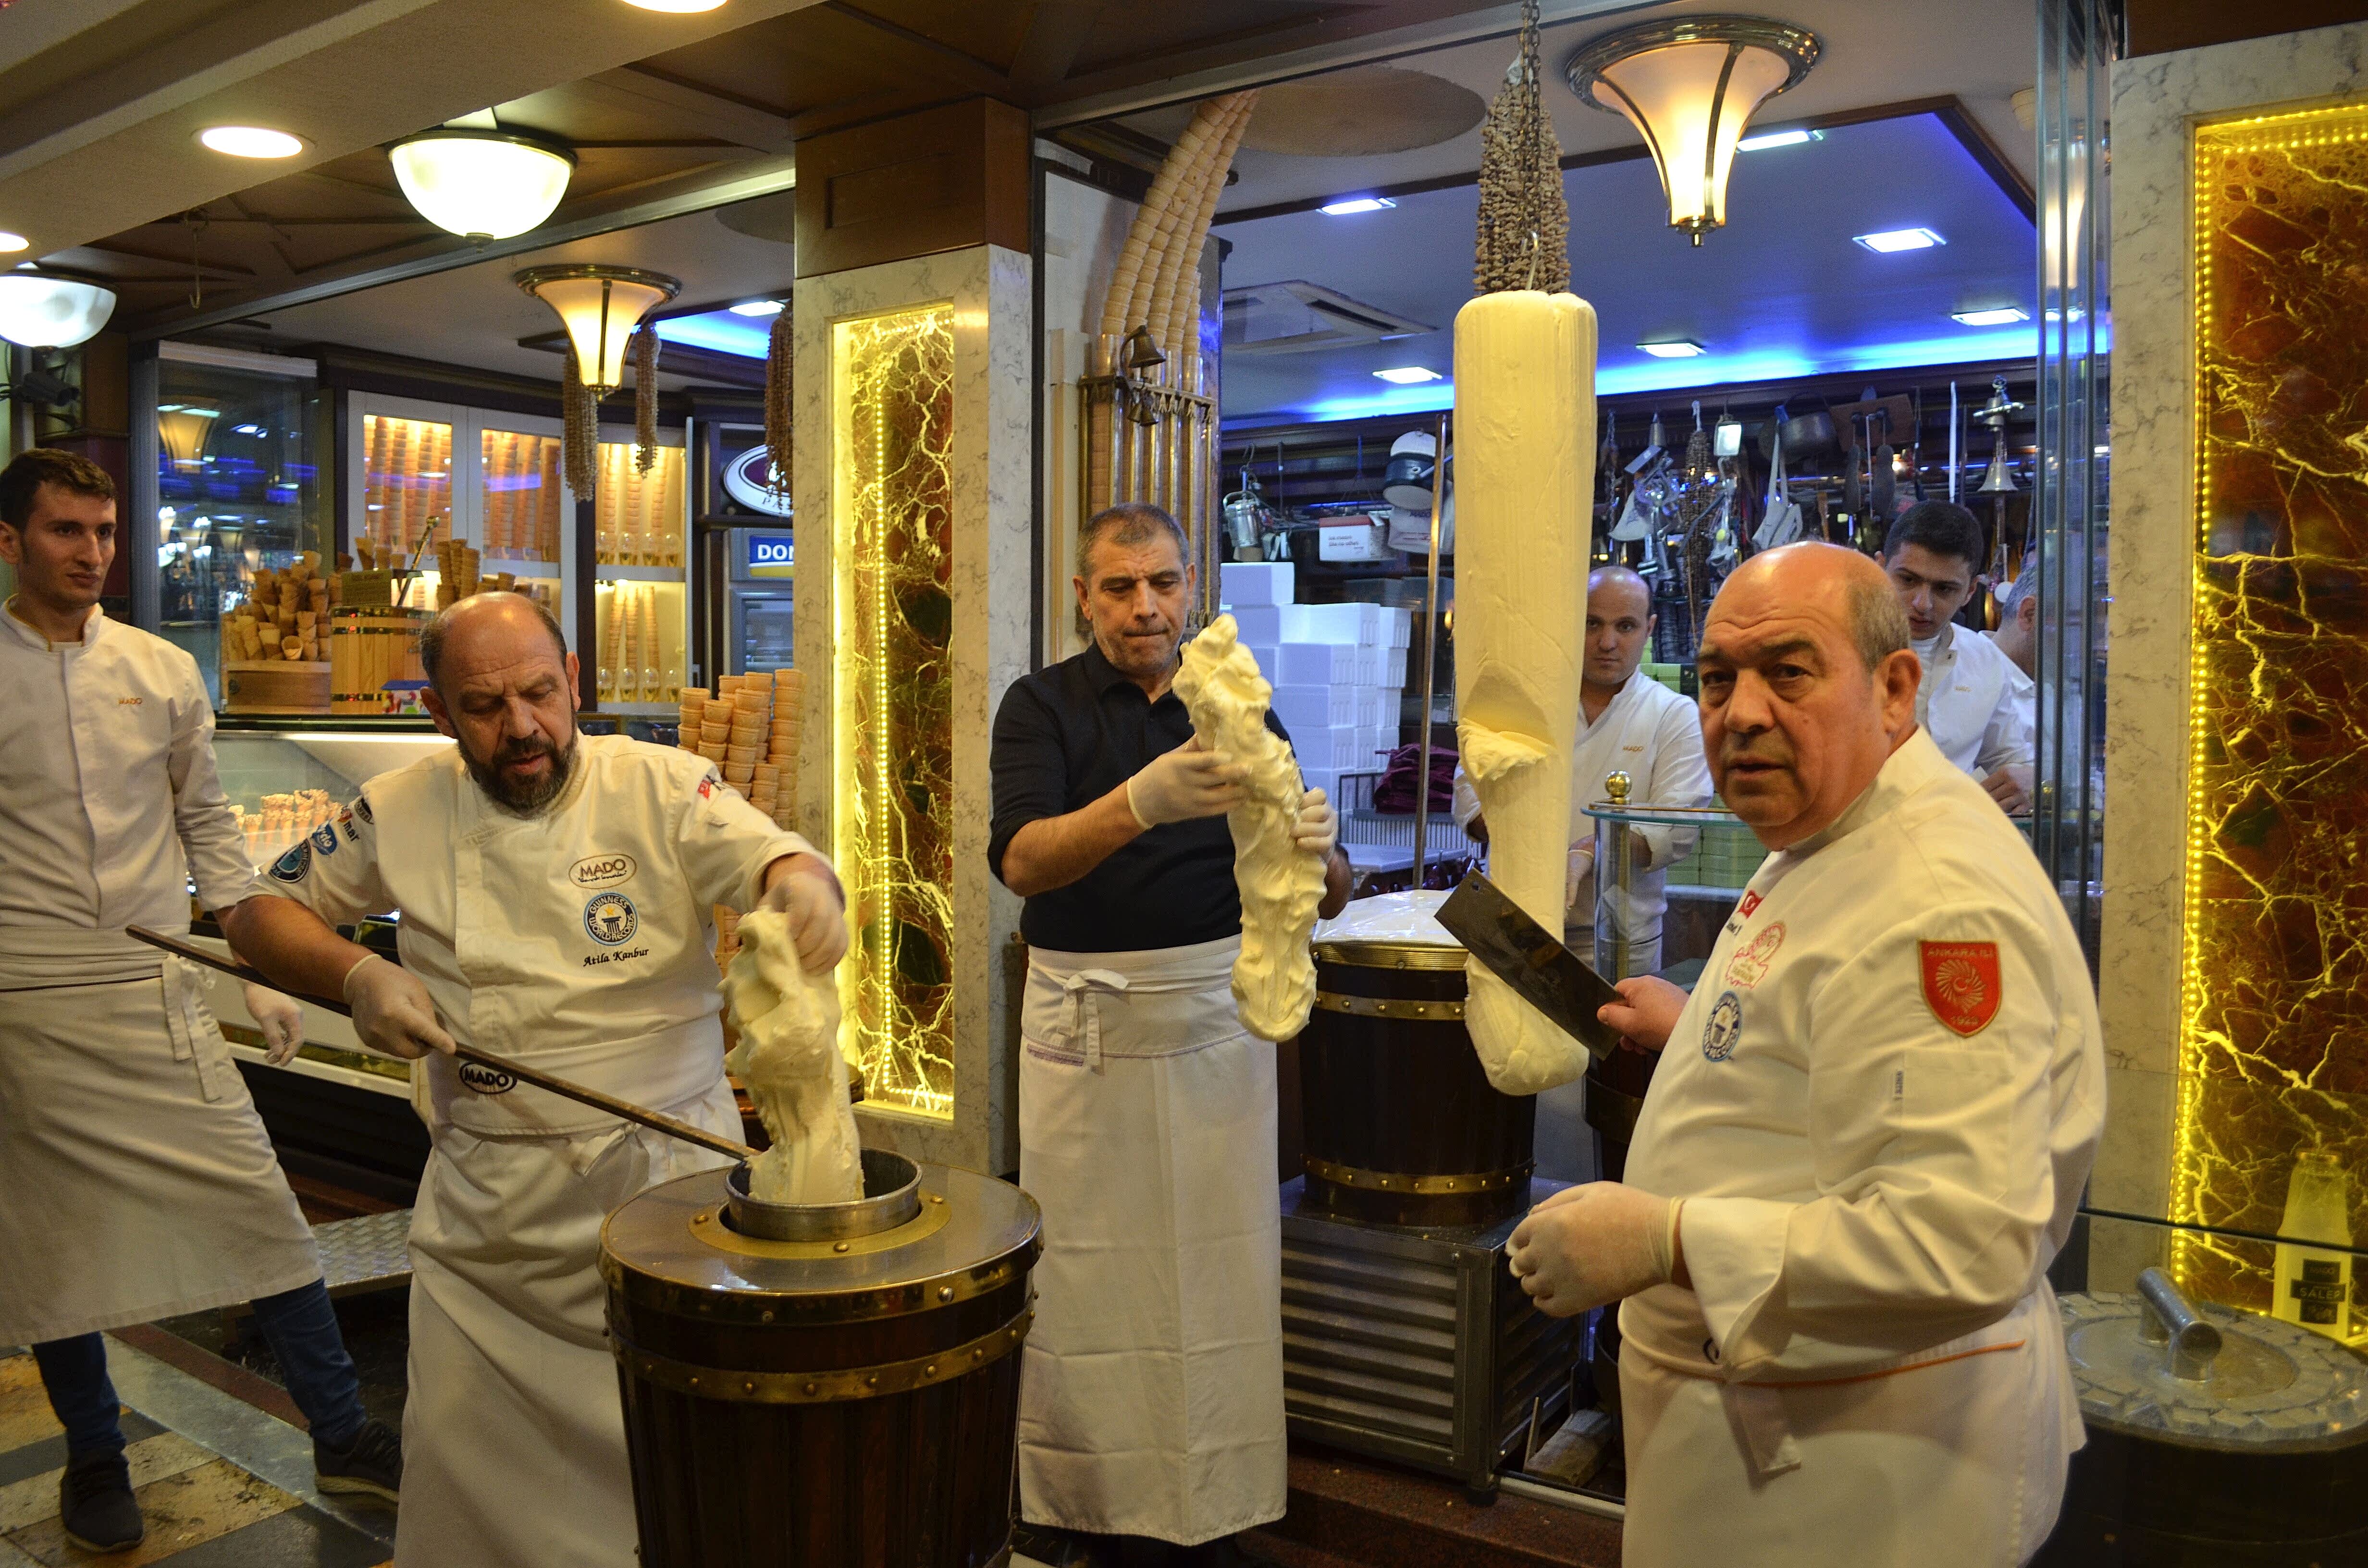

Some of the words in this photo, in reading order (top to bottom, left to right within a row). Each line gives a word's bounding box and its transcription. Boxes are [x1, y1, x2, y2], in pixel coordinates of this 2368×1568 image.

[580, 859, 626, 877] MADO
[589, 895, 629, 914] GUINNESS
[589, 917, 611, 941] WORLD
[612, 913, 635, 941] RECORDS
[583, 953, 610, 967] Atila
[613, 947, 649, 961] Kanbur
[464, 1066, 509, 1087] MADO
